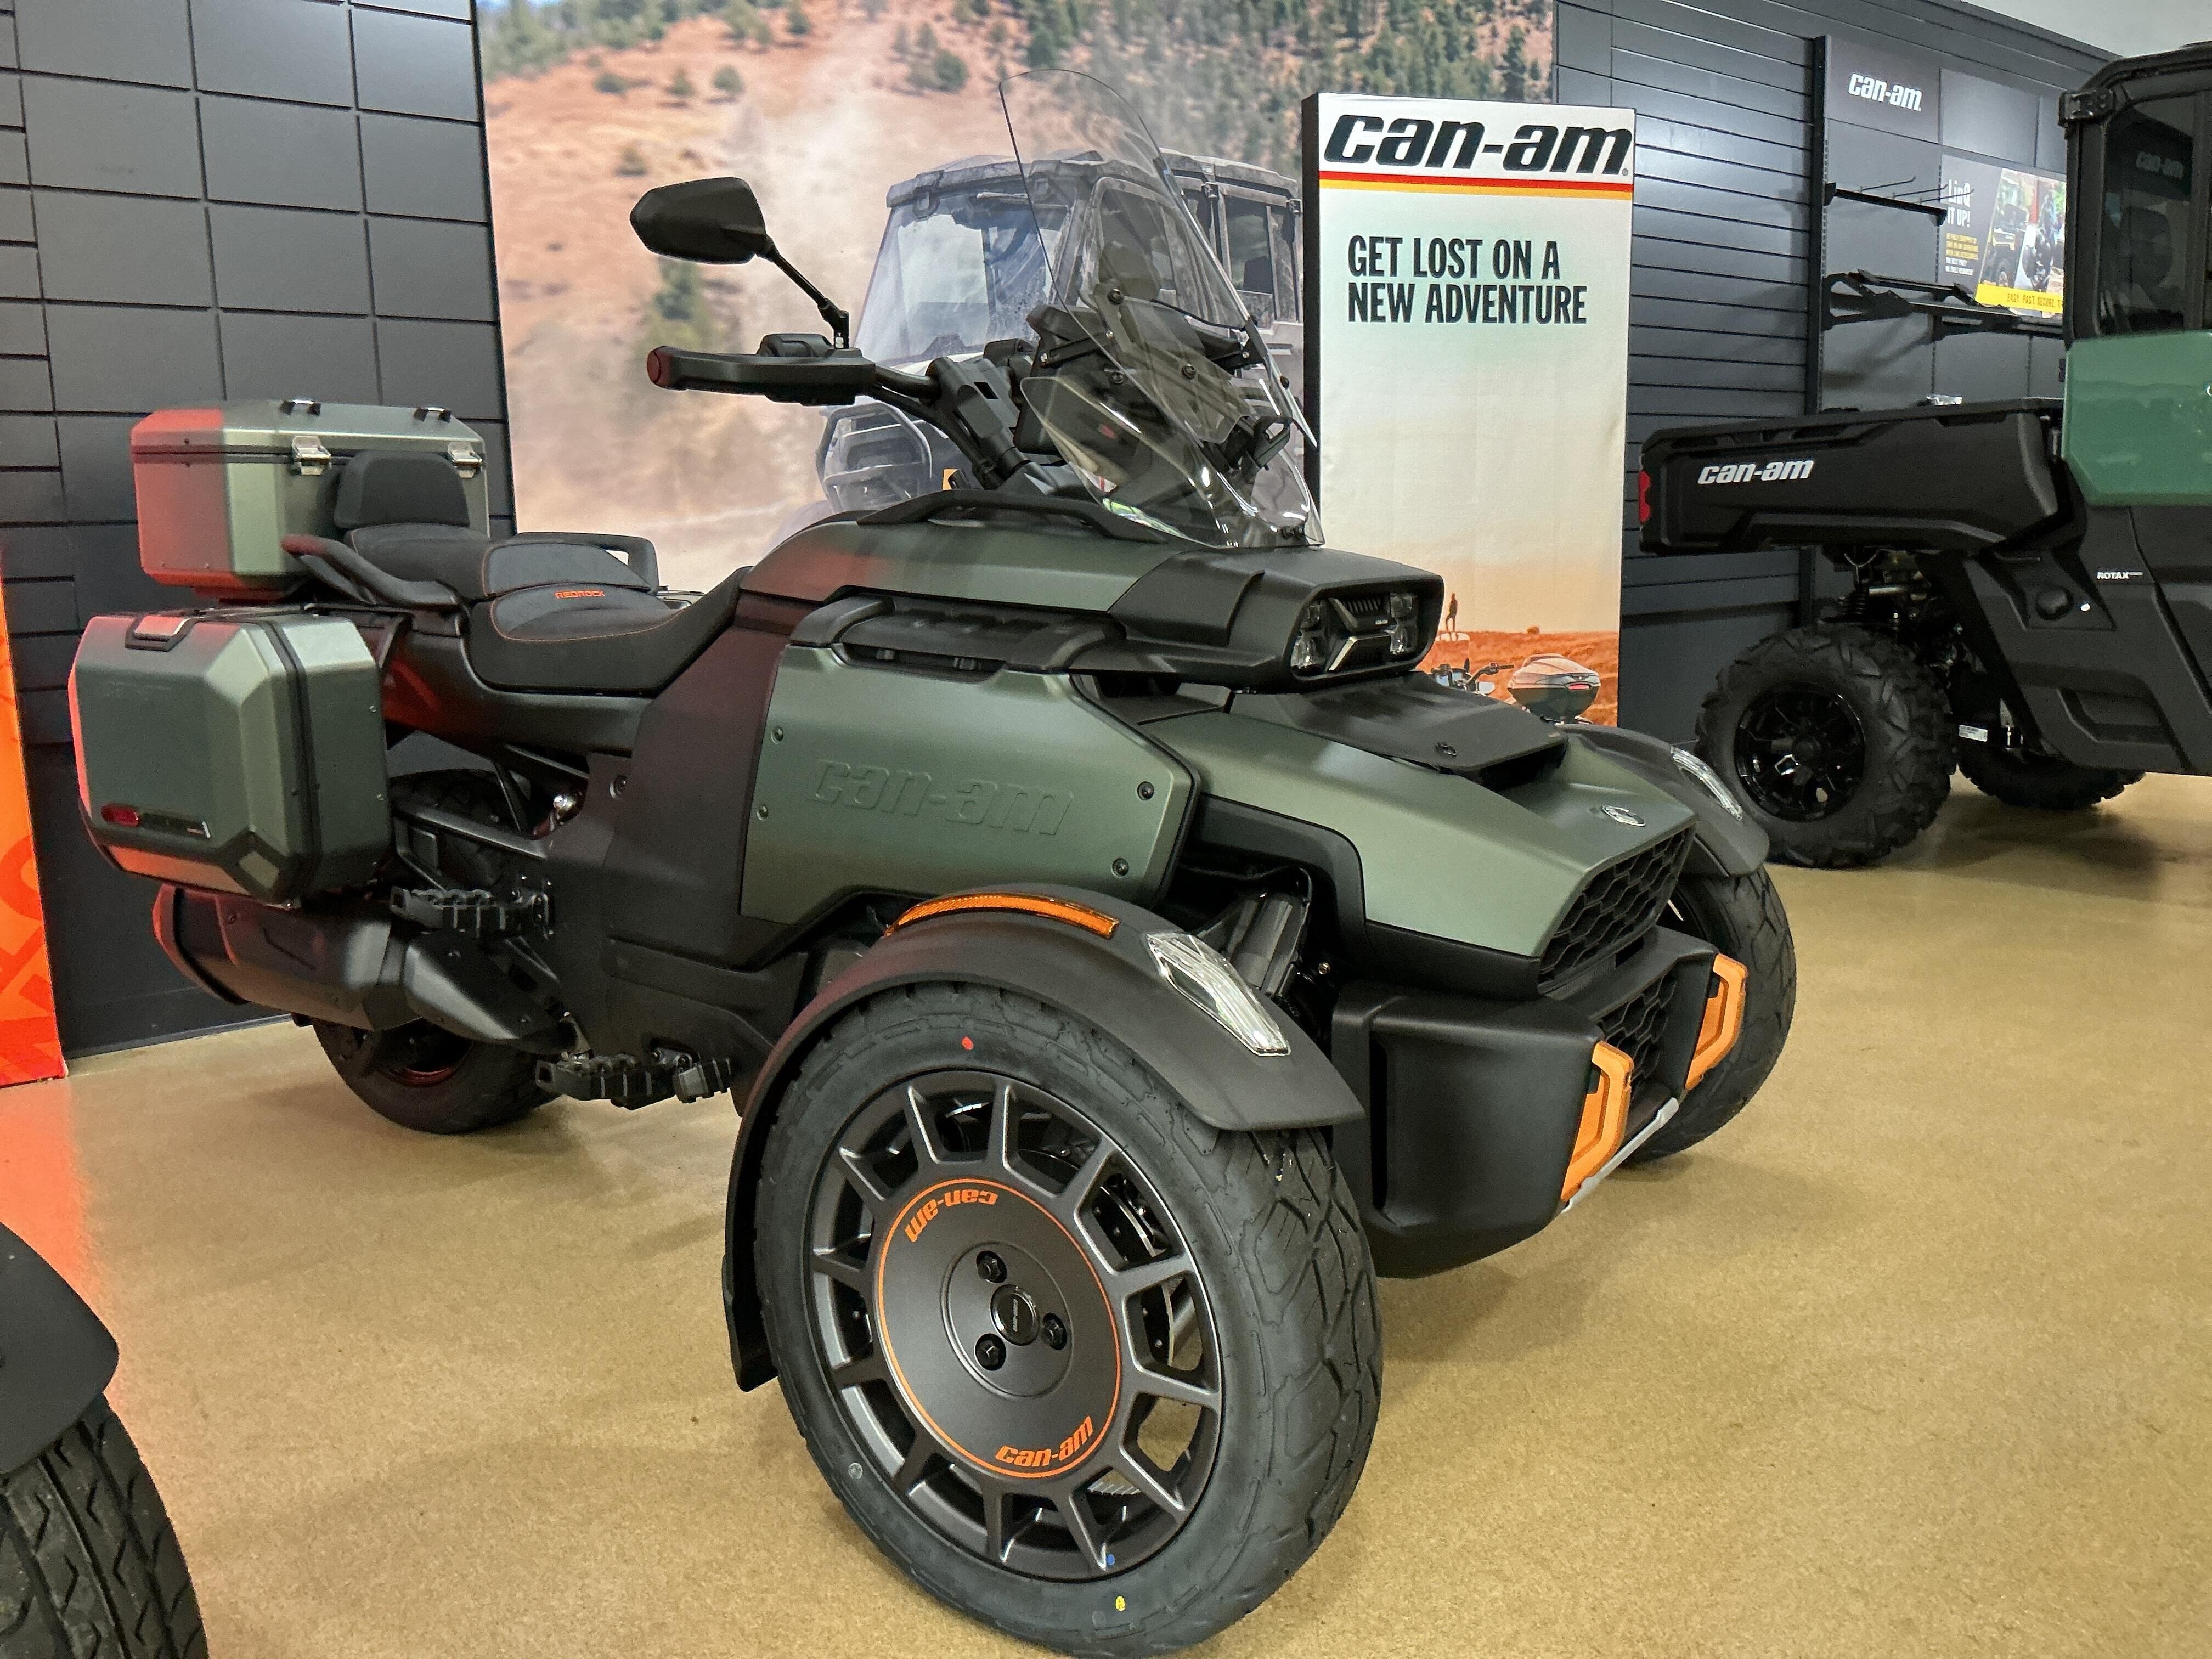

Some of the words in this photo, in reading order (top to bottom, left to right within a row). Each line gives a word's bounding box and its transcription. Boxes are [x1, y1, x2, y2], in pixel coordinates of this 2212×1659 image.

[1848, 74, 1922, 111] can-am
[1324, 114, 1632, 174] can-am
[1948, 179, 1970, 207] LinQ
[1948, 207, 1955, 224] IT
[1956, 209, 1970, 228] UP!
[1348, 235, 1403, 277] GET
[1413, 238, 1483, 278] LOST
[1492, 240, 1532, 279] ON
[1542, 241, 1560, 279] A
[1348, 283, 1415, 323] NEW
[1425, 284, 1587, 324] ADVENTURE
[1698, 460, 1814, 484] can-am
[808, 760, 1074, 836] can-am
[905, 1189, 998, 1243] can-am
[995, 1415, 1093, 1467] can-am
